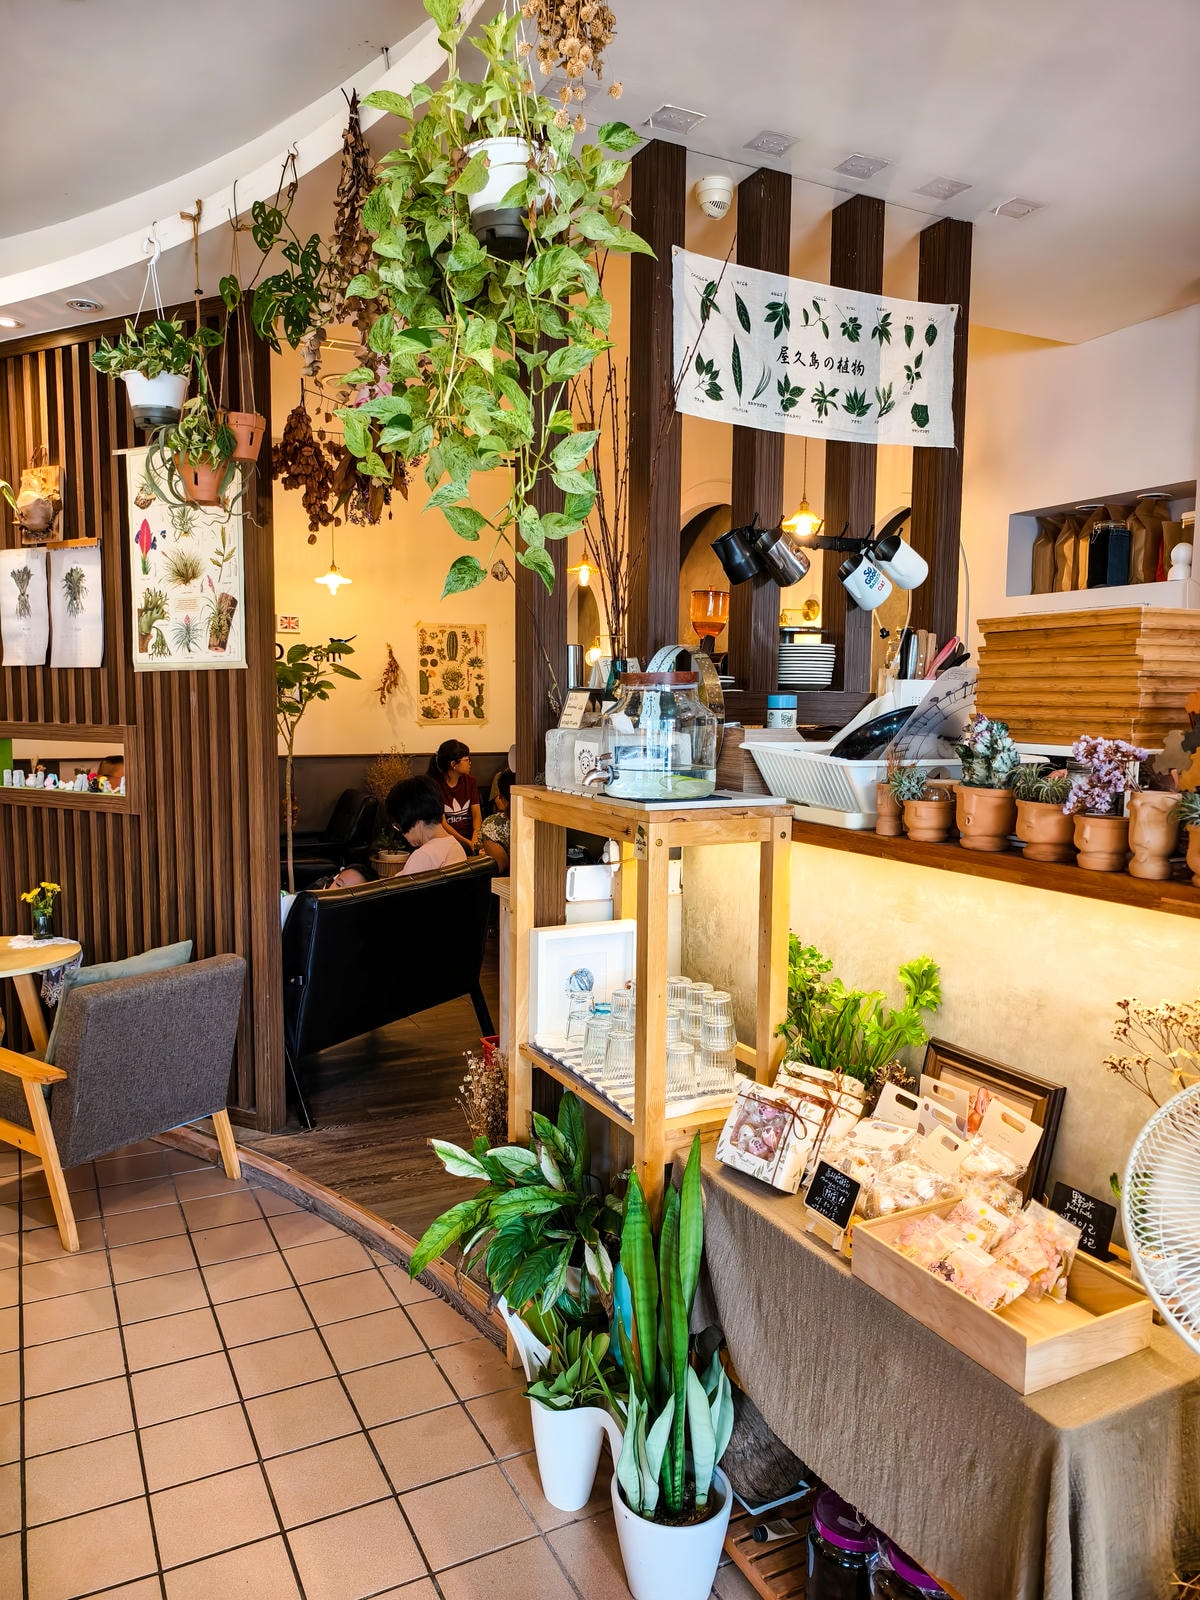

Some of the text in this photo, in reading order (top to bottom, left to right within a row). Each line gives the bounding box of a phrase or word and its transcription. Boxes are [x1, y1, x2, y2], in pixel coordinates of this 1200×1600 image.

[776, 345, 865, 377] 屋久島の植物
[863, 567, 872, 578] So
